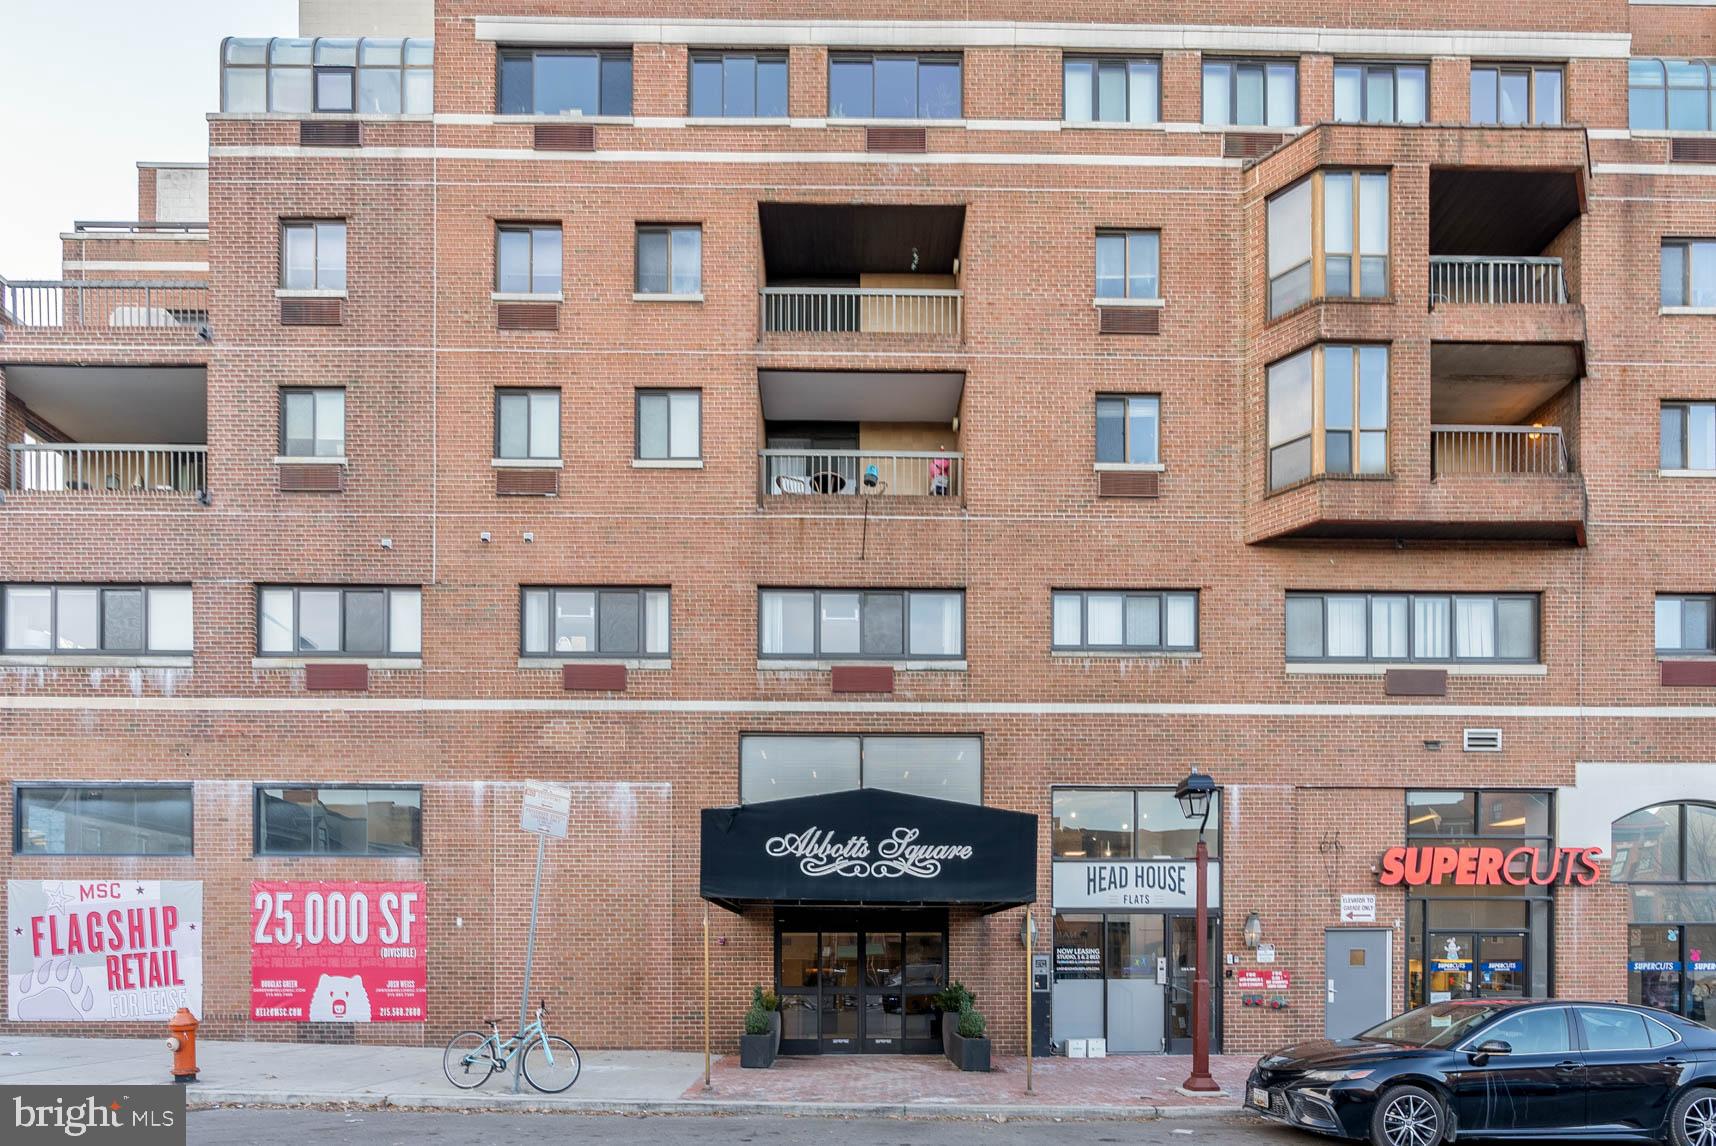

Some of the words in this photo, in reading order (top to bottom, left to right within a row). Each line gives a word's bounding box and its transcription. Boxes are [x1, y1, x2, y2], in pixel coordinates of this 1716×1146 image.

[765, 826, 870, 860] Abbotts
[878, 827, 973, 866] Square
[1086, 865, 1129, 896] HEAD
[1135, 865, 1187, 896] HOUSE
[1379, 846, 1603, 886] SUPERCUTS
[79, 882, 121, 901] MSC
[1123, 894, 1150, 905] FLATS
[31, 905, 179, 958] FLAGSHIP
[254, 891, 369, 950] 25,000
[378, 891, 418, 945] SF
[106, 949, 185, 992] RETAIL
[1633, 962, 1674, 971] SUPERCUTS
[1694, 962, 1716, 970] SUPER
[109, 991, 140, 1019] FOR
[143, 987, 187, 1016] LEASE
